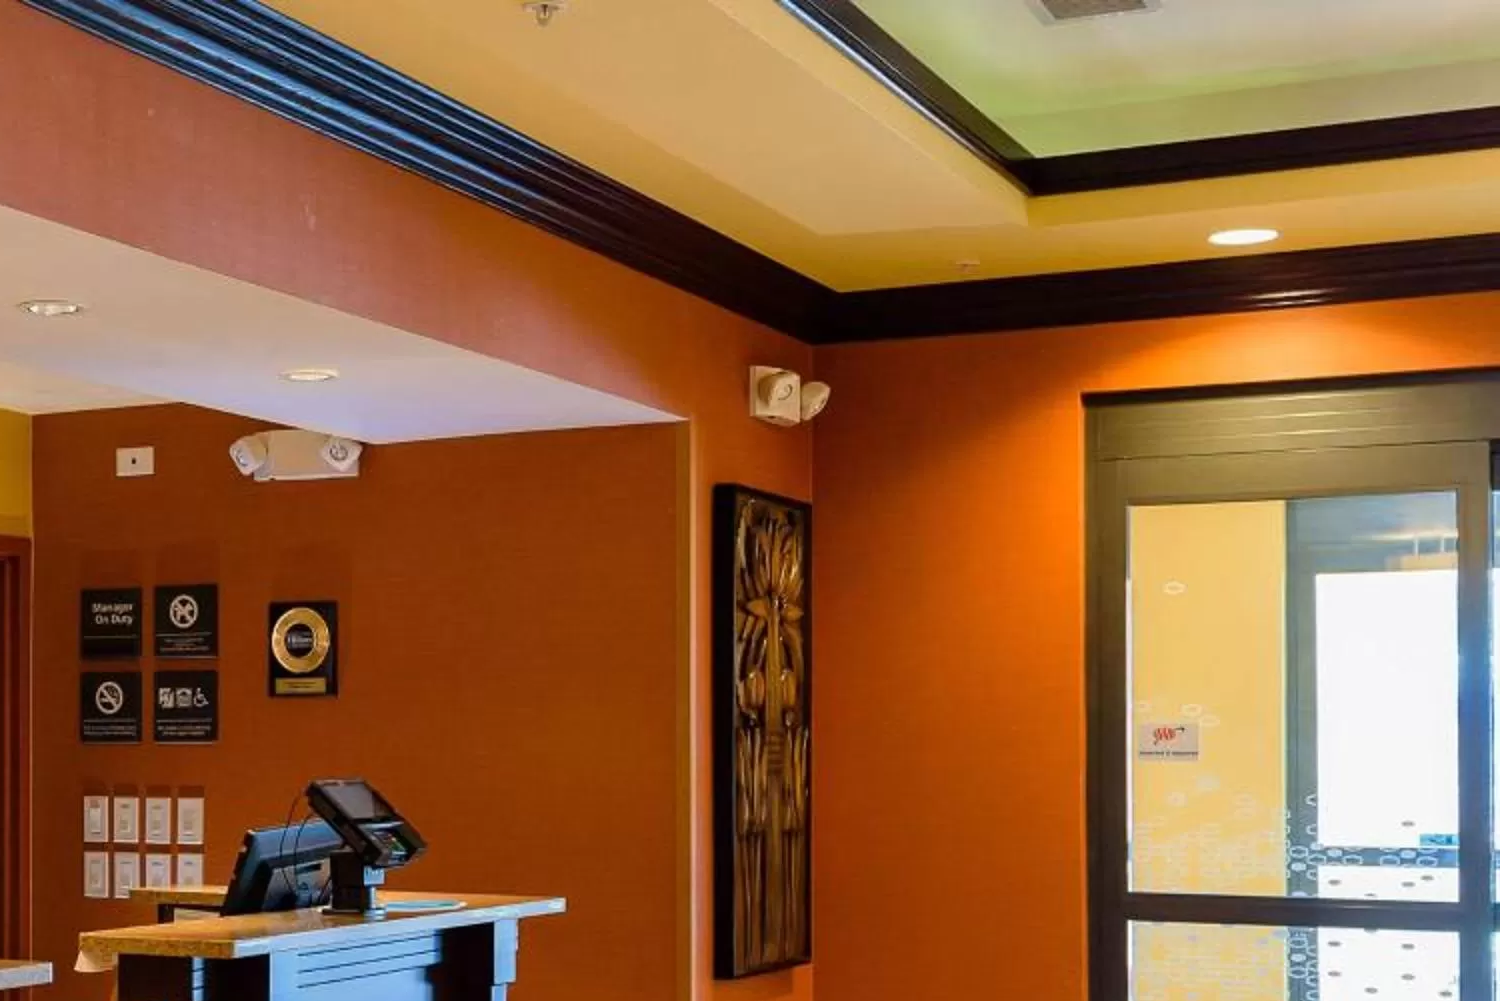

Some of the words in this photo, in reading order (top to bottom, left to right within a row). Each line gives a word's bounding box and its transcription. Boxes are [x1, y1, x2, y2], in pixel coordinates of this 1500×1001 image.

[92, 602, 133, 615] Manager
[95, 614, 109, 625] On
[111, 614, 133, 626] Duty
